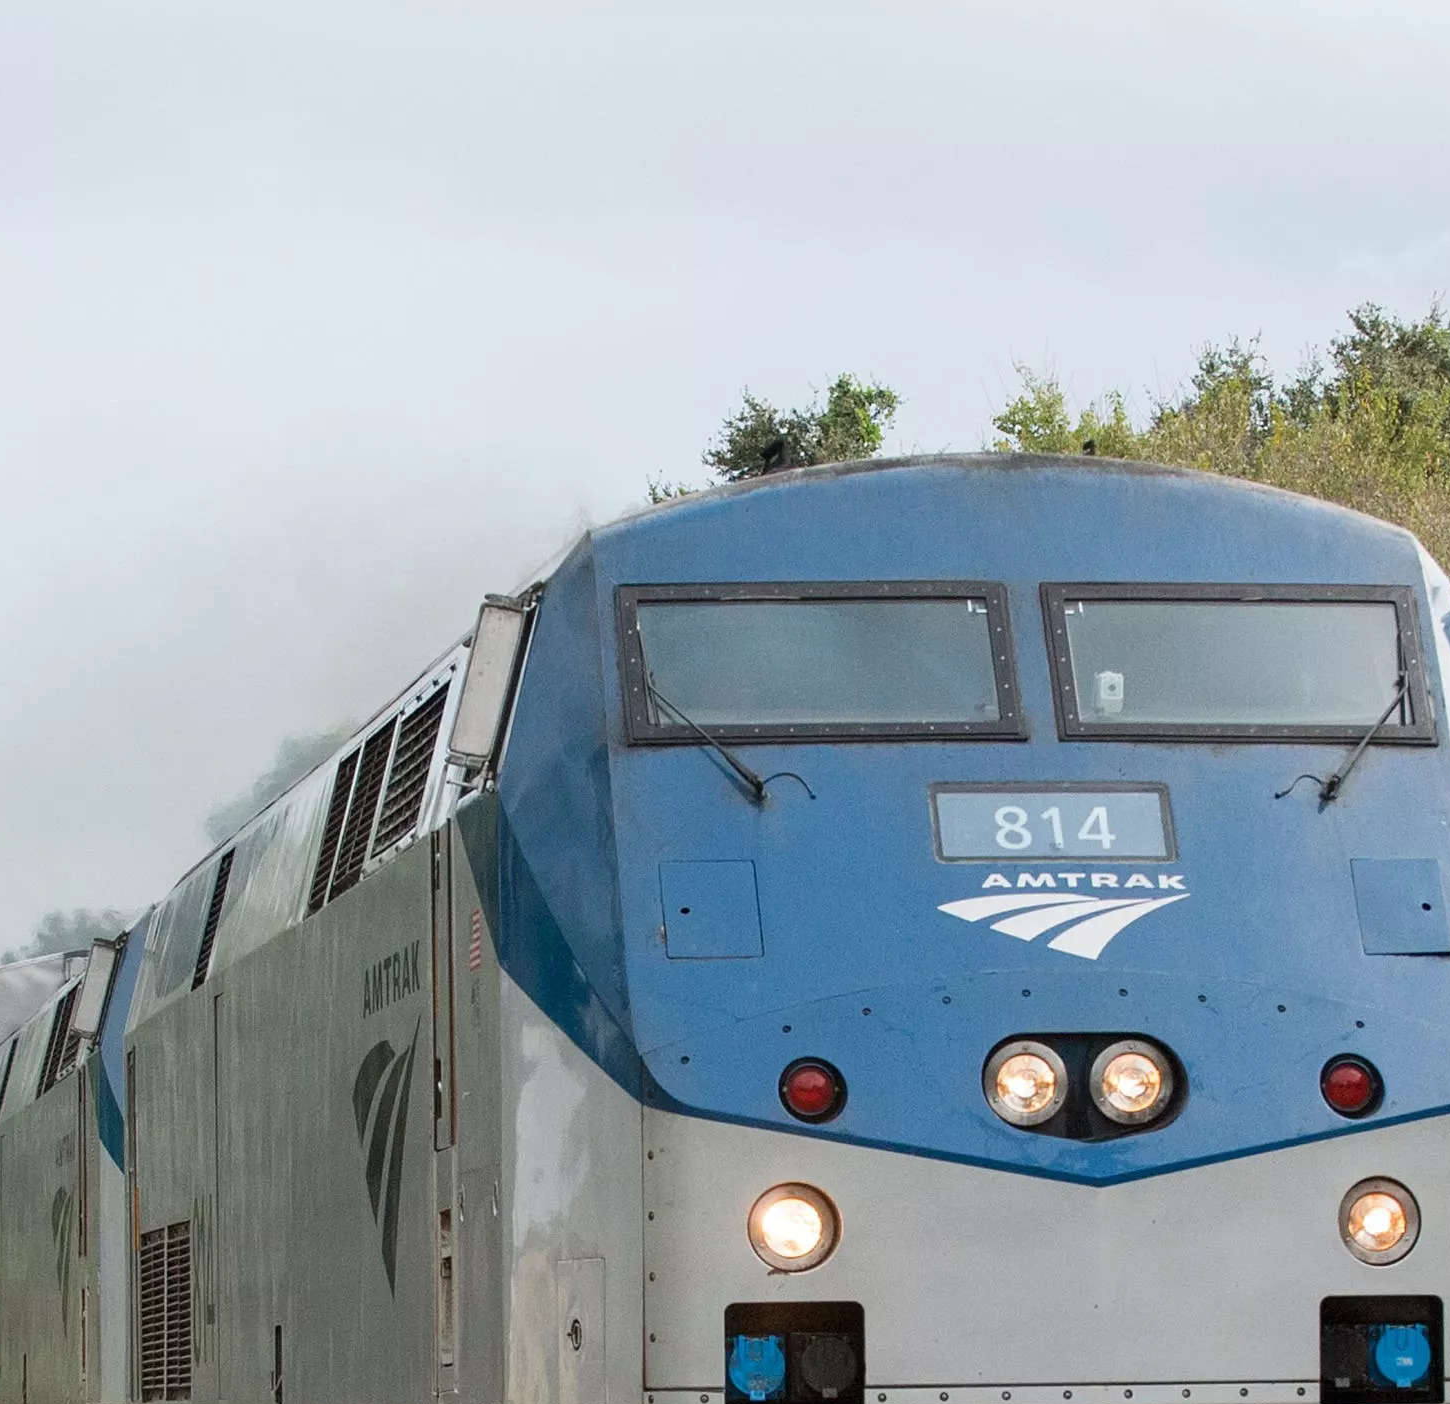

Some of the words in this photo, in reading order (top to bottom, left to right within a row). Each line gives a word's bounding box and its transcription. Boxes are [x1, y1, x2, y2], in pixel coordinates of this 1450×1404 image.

[994, 806, 1116, 850] 814
[981, 872, 1187, 890] AMTRAK
[363, 939, 420, 1020] AMTRAK
